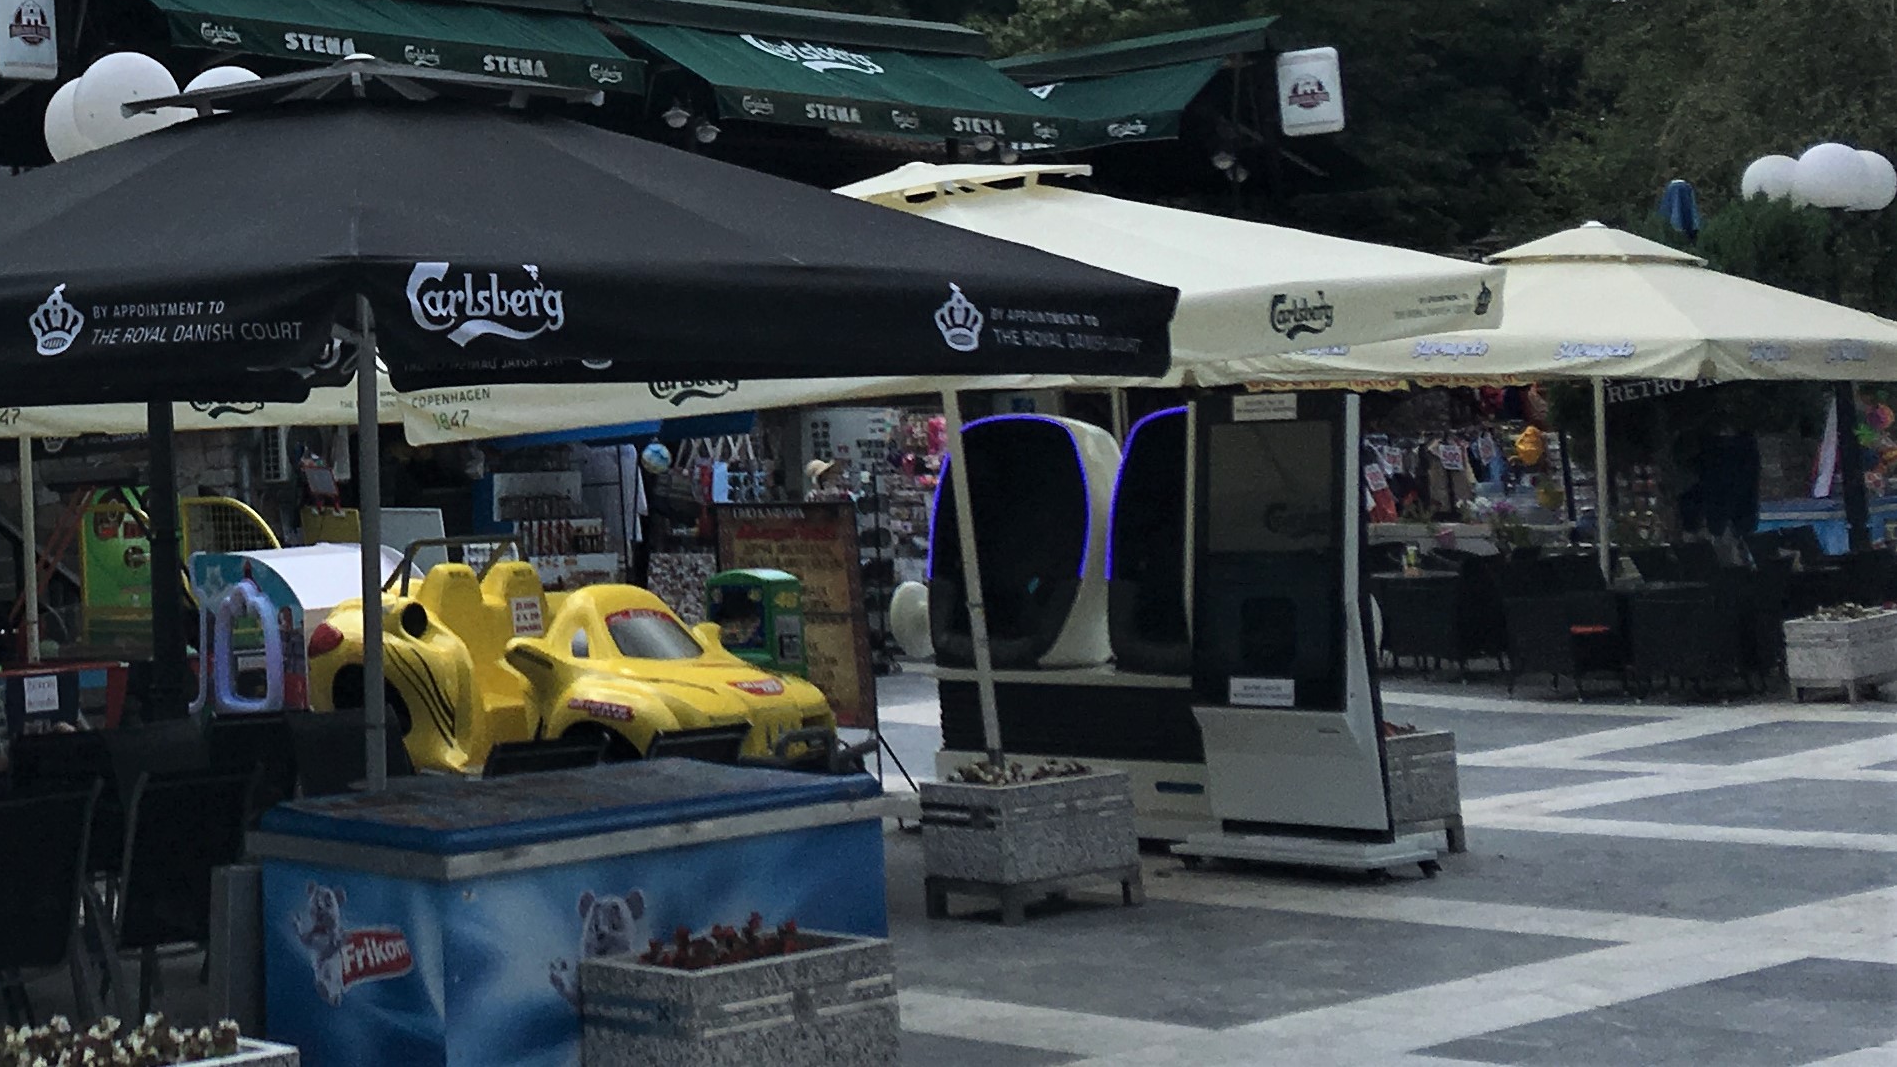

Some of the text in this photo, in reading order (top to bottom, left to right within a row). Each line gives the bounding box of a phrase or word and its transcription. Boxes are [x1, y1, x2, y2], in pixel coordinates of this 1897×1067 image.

[92, 300, 225, 319] BY APPOINTMENT TO
[406, 261, 565, 347] Carlsberg
[1270, 290, 1334, 340] Carlsberg
[91, 321, 303, 345] THE ROYAL DANISH COURT
[410, 387, 491, 409] COPENHAGEN
[431, 409, 470, 431] 1847
